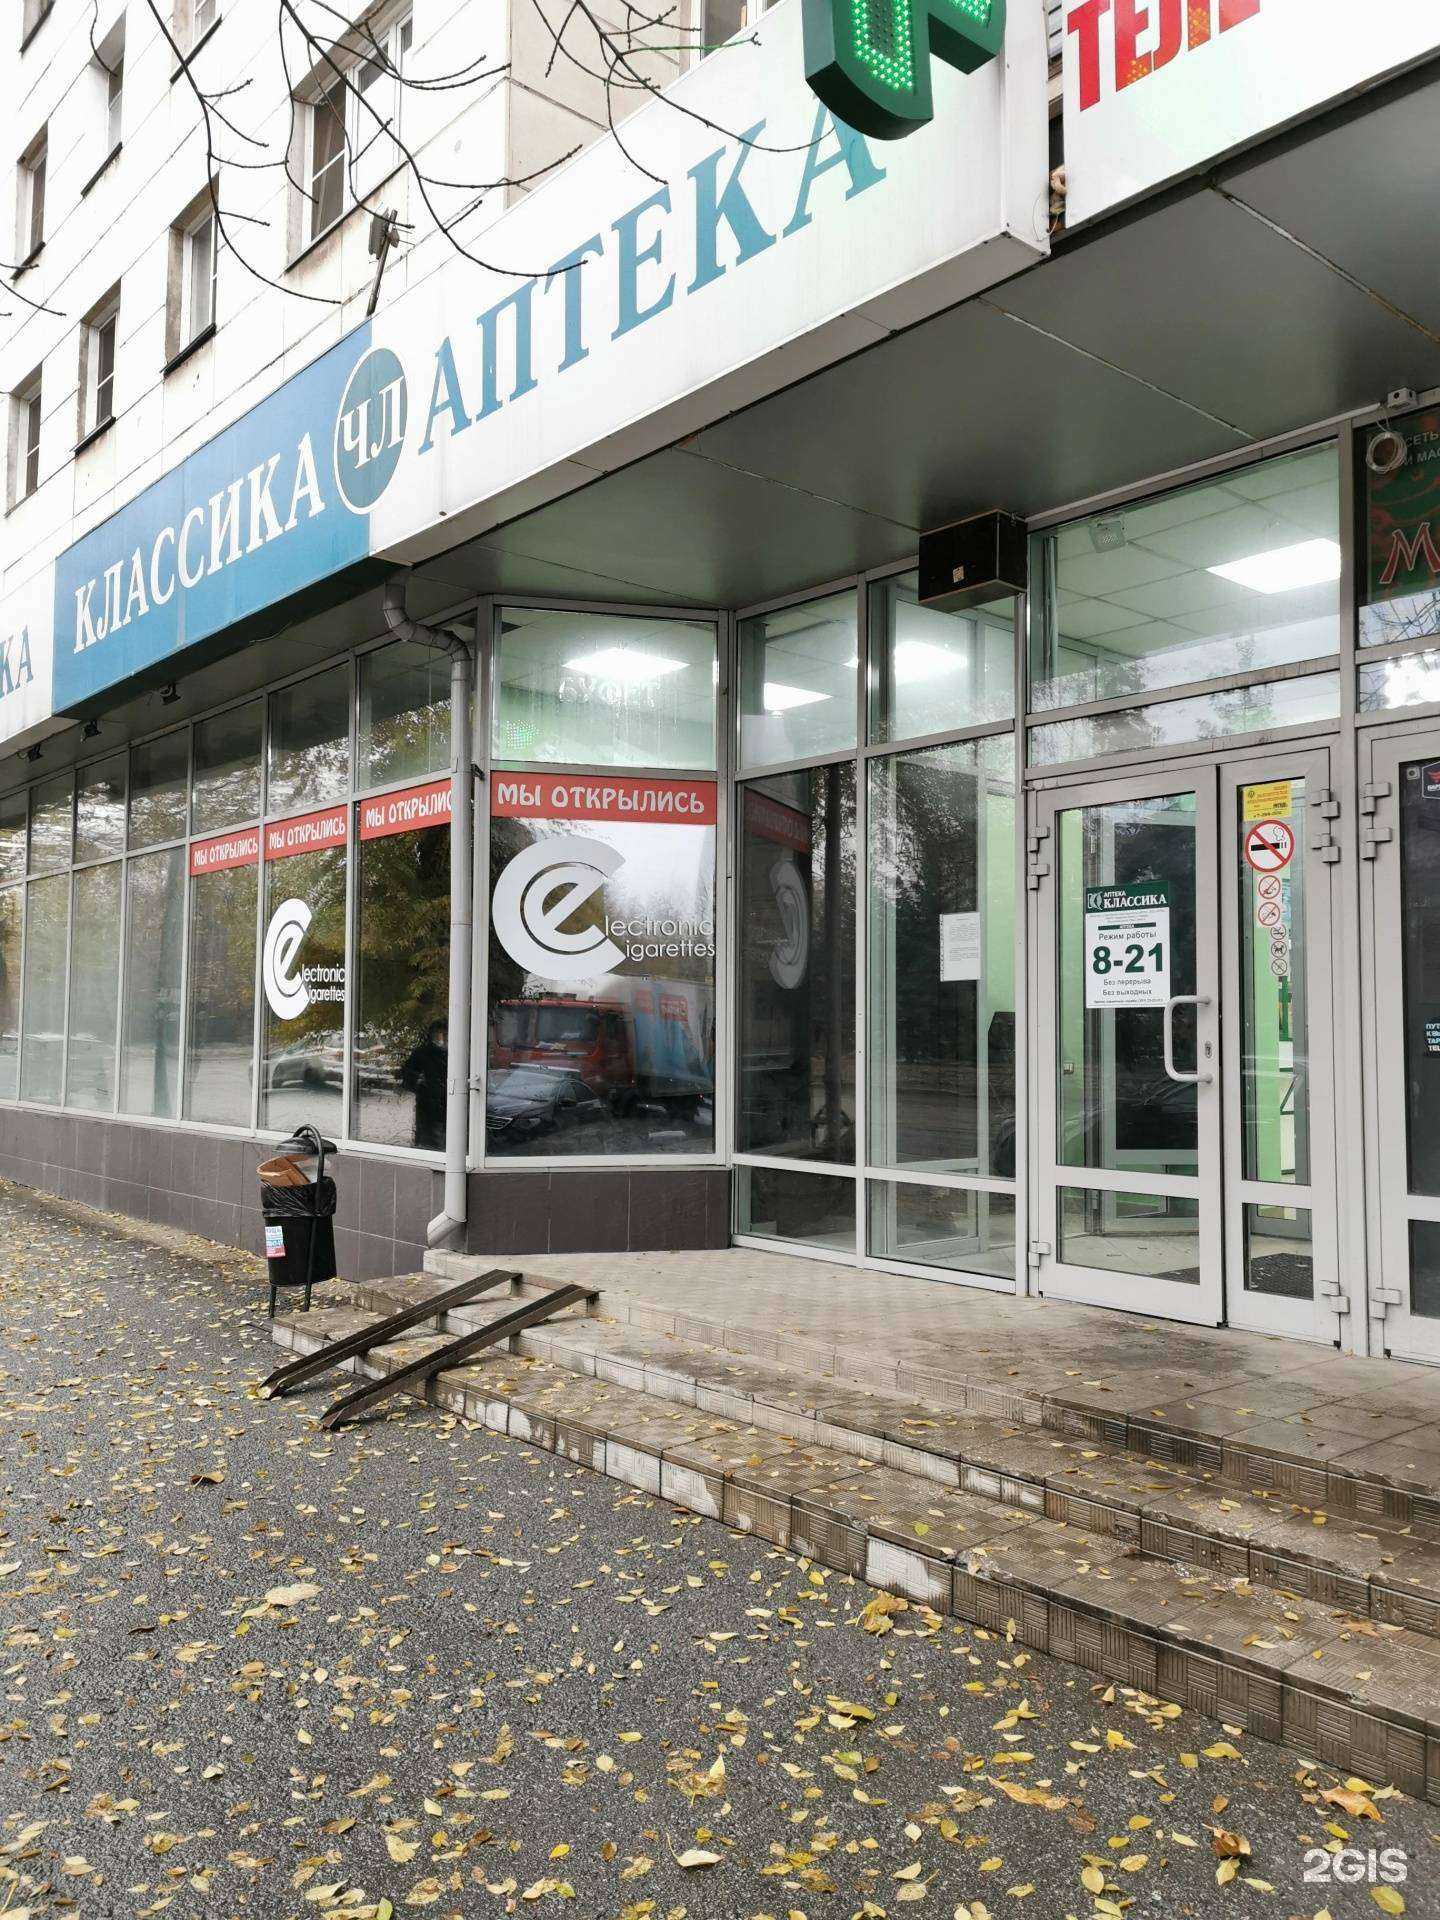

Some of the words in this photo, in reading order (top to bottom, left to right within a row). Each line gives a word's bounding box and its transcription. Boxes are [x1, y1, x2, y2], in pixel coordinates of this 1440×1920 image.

[1067, 0, 1261, 112] ТЕЛ
[417, 95, 887, 456] АПТЕКА
[340, 375, 405, 470] ЧЛ
[73, 431, 326, 654] КЛАССИКА
[366, 808, 385, 828] МЫ
[389, 790, 452, 824] ОТКРЫЛИС
[497, 783, 542, 807] МЫ
[551, 786, 705, 814] ОТКРЫЛИСЬ
[269, 832, 284, 850] МЫ
[287, 816, 345, 845] ОТКРЫЛИСЬ
[194, 849, 207, 867] МЫ
[209, 838, 258, 863] ОТКРЫЛИСЬ
[1103, 890, 1127, 898] АПТЕКА
[1103, 894, 1168, 909] КЛАССИКА
[1126, 931, 1157, 940] работы
[1093, 942, 1163, 974] 8-21
